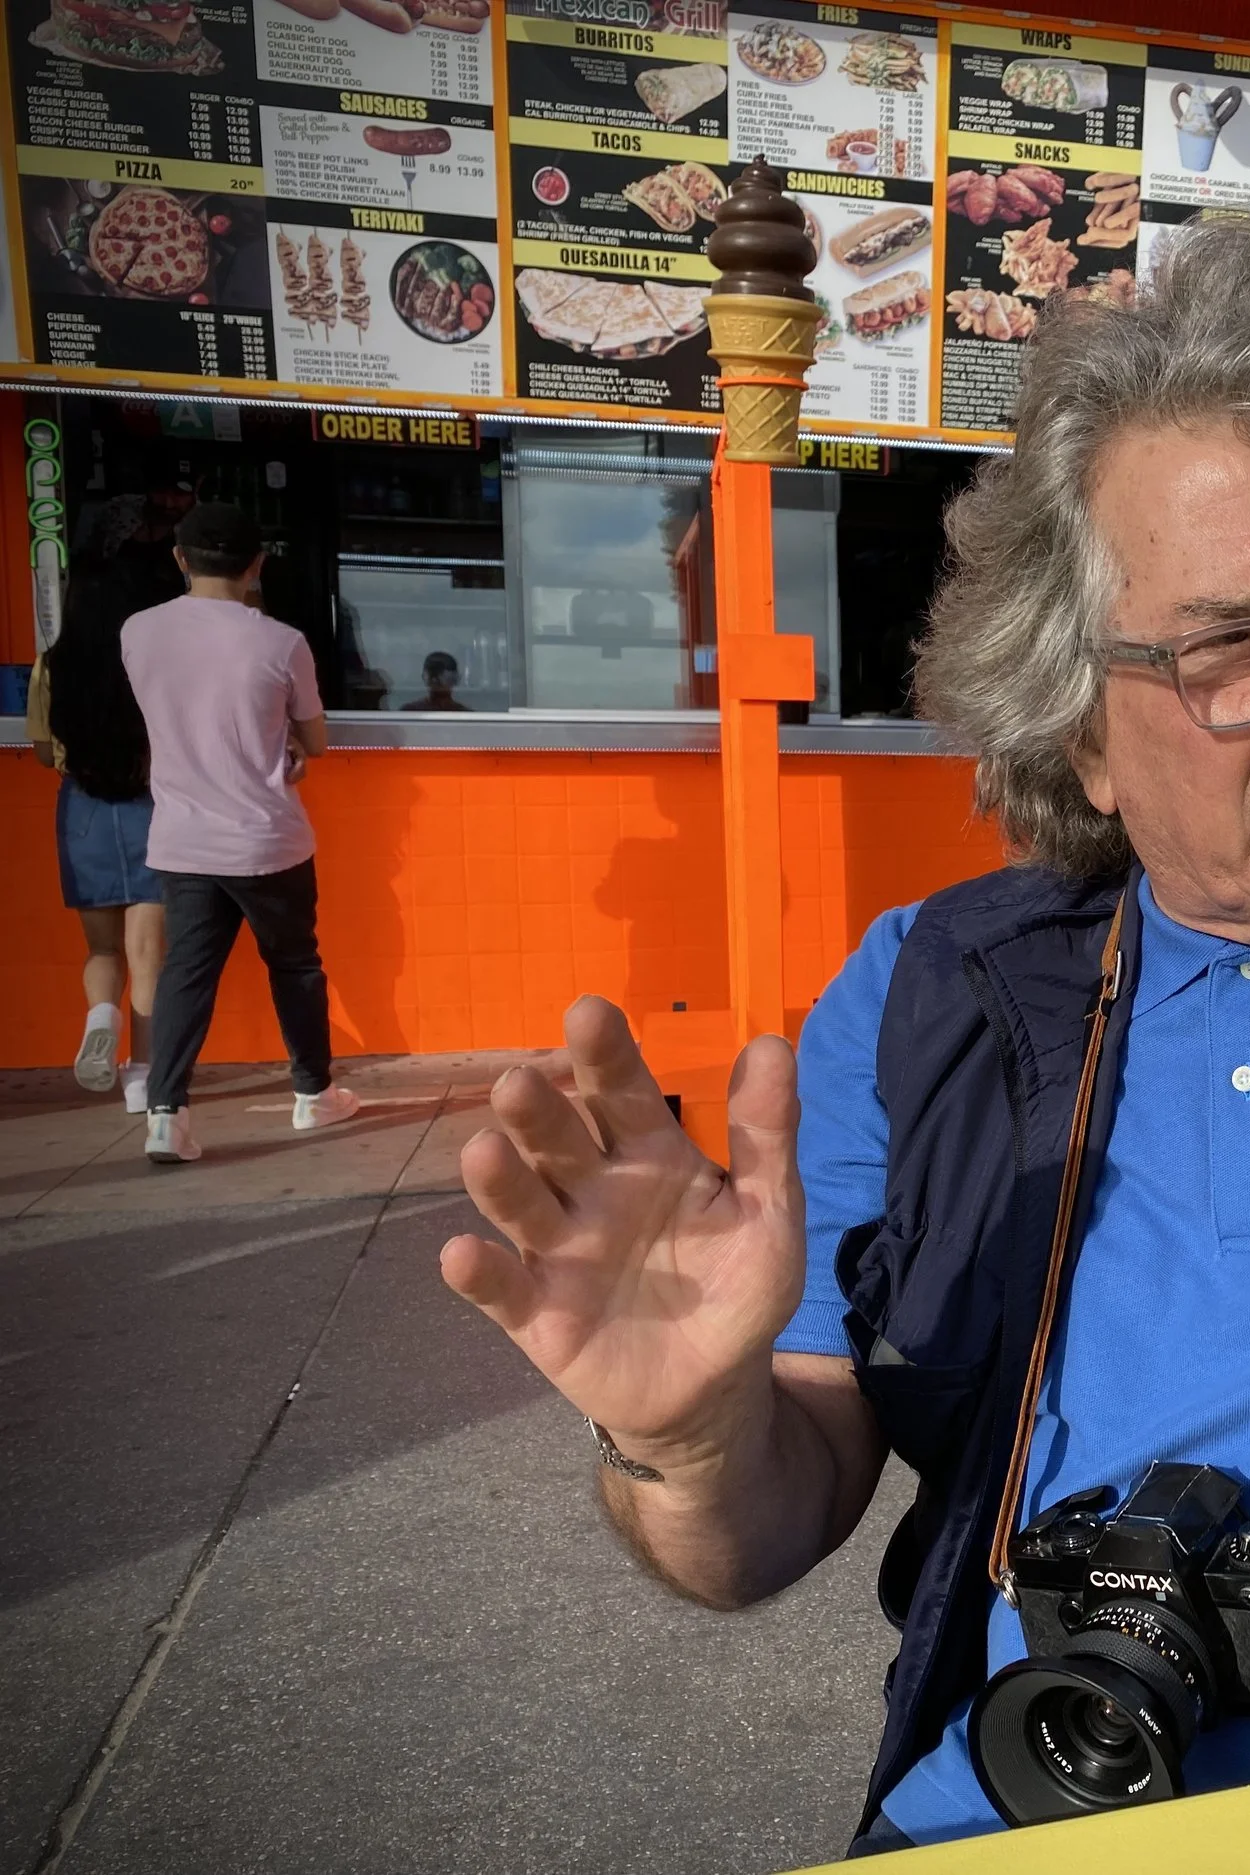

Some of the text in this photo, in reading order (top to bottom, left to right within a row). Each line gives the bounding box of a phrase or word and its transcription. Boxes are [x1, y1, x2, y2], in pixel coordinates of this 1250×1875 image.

[664, 0, 720, 32] Grill
[817, 4, 859, 24] FRIES
[267, 21, 315, 33] CORN DOG
[267, 31, 348, 47] CLASSIC HOT DOG
[575, 27, 654, 53] BURRITOS
[1021, 29, 1072, 50] WRAPS
[26, 86, 104, 101] VEGGIE BURGER
[27, 96, 109, 111] CLASSIC BURGER
[737, 89, 788, 102] CURLY FRIES
[28, 106, 108, 121] CHEESE BURGER
[340, 92, 428, 120] SAUSAGES
[451, 116, 487, 127] ORGANIC
[592, 131, 642, 152] TACOS
[1015, 142, 1070, 163] SNACKS
[115, 159, 162, 181] PIZZA
[429, 163, 484, 178] 8.99 13.99
[787, 171, 885, 198] SANDWICHES
[350, 208, 425, 233] TERIYAKI
[560, 248, 650, 272] QUESADILLA
[320, 413, 473, 445] ORDER HERE
[821, 441, 879, 470] HERE
[1089, 1569, 1174, 1594] CONTAX
[1138, 1707, 1162, 1735] JAPAN
[1053, 1752, 1073, 1773] Carl
